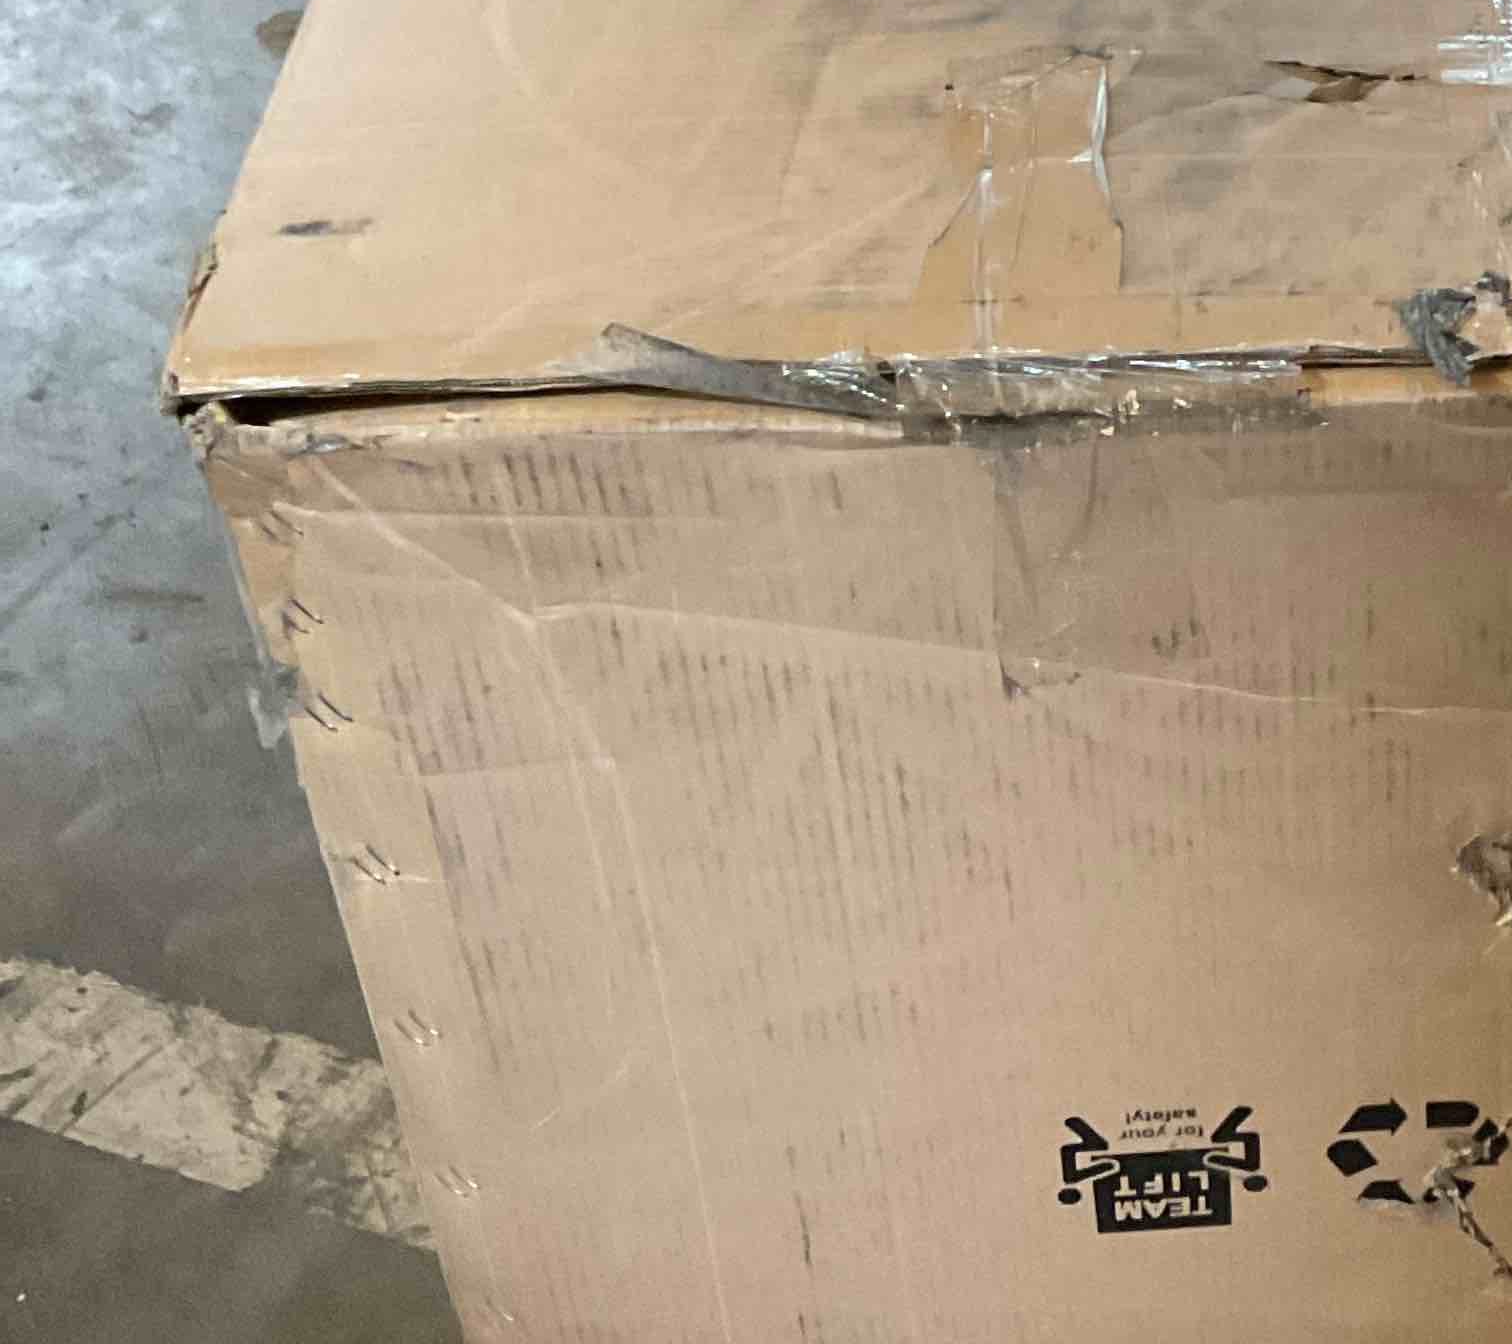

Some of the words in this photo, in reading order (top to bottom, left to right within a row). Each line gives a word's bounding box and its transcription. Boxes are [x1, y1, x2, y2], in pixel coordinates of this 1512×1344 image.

[1119, 1124, 1168, 1142] your
[1175, 1124, 1204, 1138] for
[1113, 1170, 1211, 1197] LIFT
[1113, 1196, 1213, 1222] TEAM
